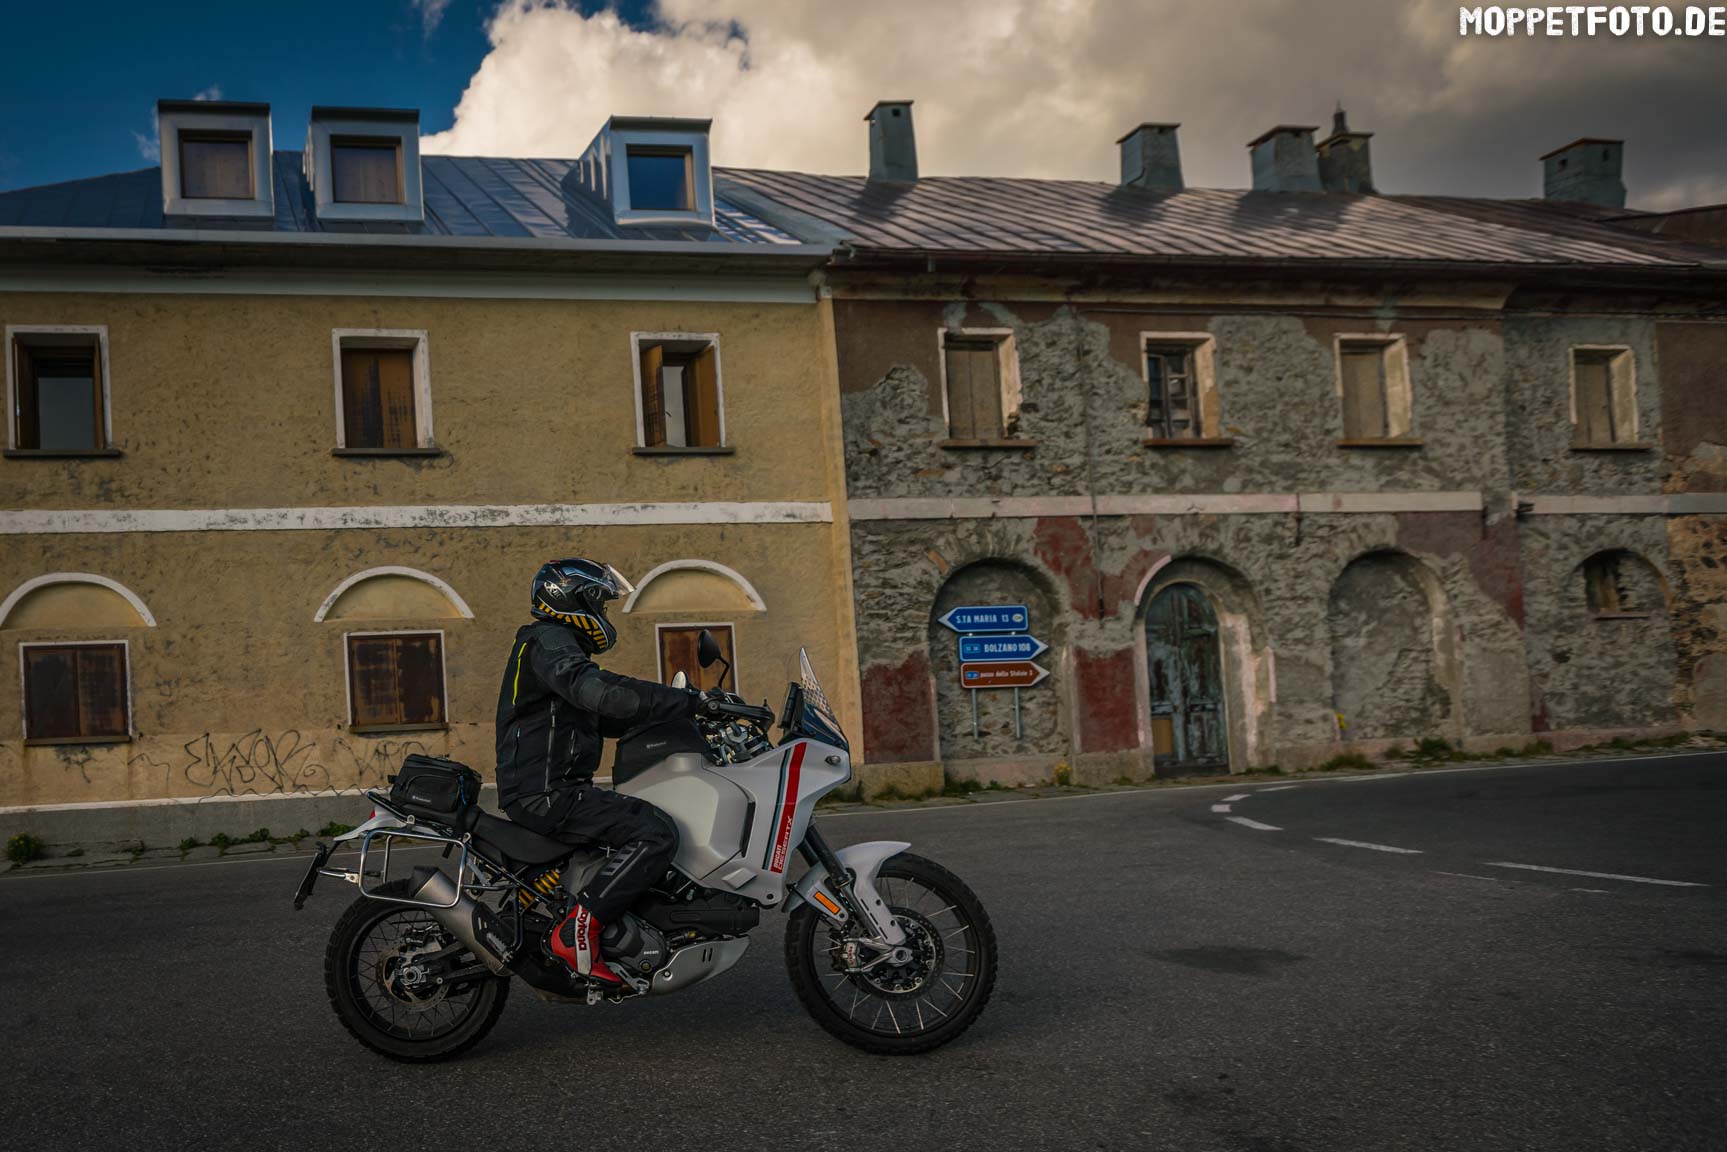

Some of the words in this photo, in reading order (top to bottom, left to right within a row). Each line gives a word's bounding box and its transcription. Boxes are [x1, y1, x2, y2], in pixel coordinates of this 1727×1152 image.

[973, 614, 998, 623] MARIA
[1001, 614, 1010, 623] 13
[984, 643, 1018, 653] BOLZANO
[773, 844, 782, 869] DUCATI
[577, 908, 589, 951] aytona
